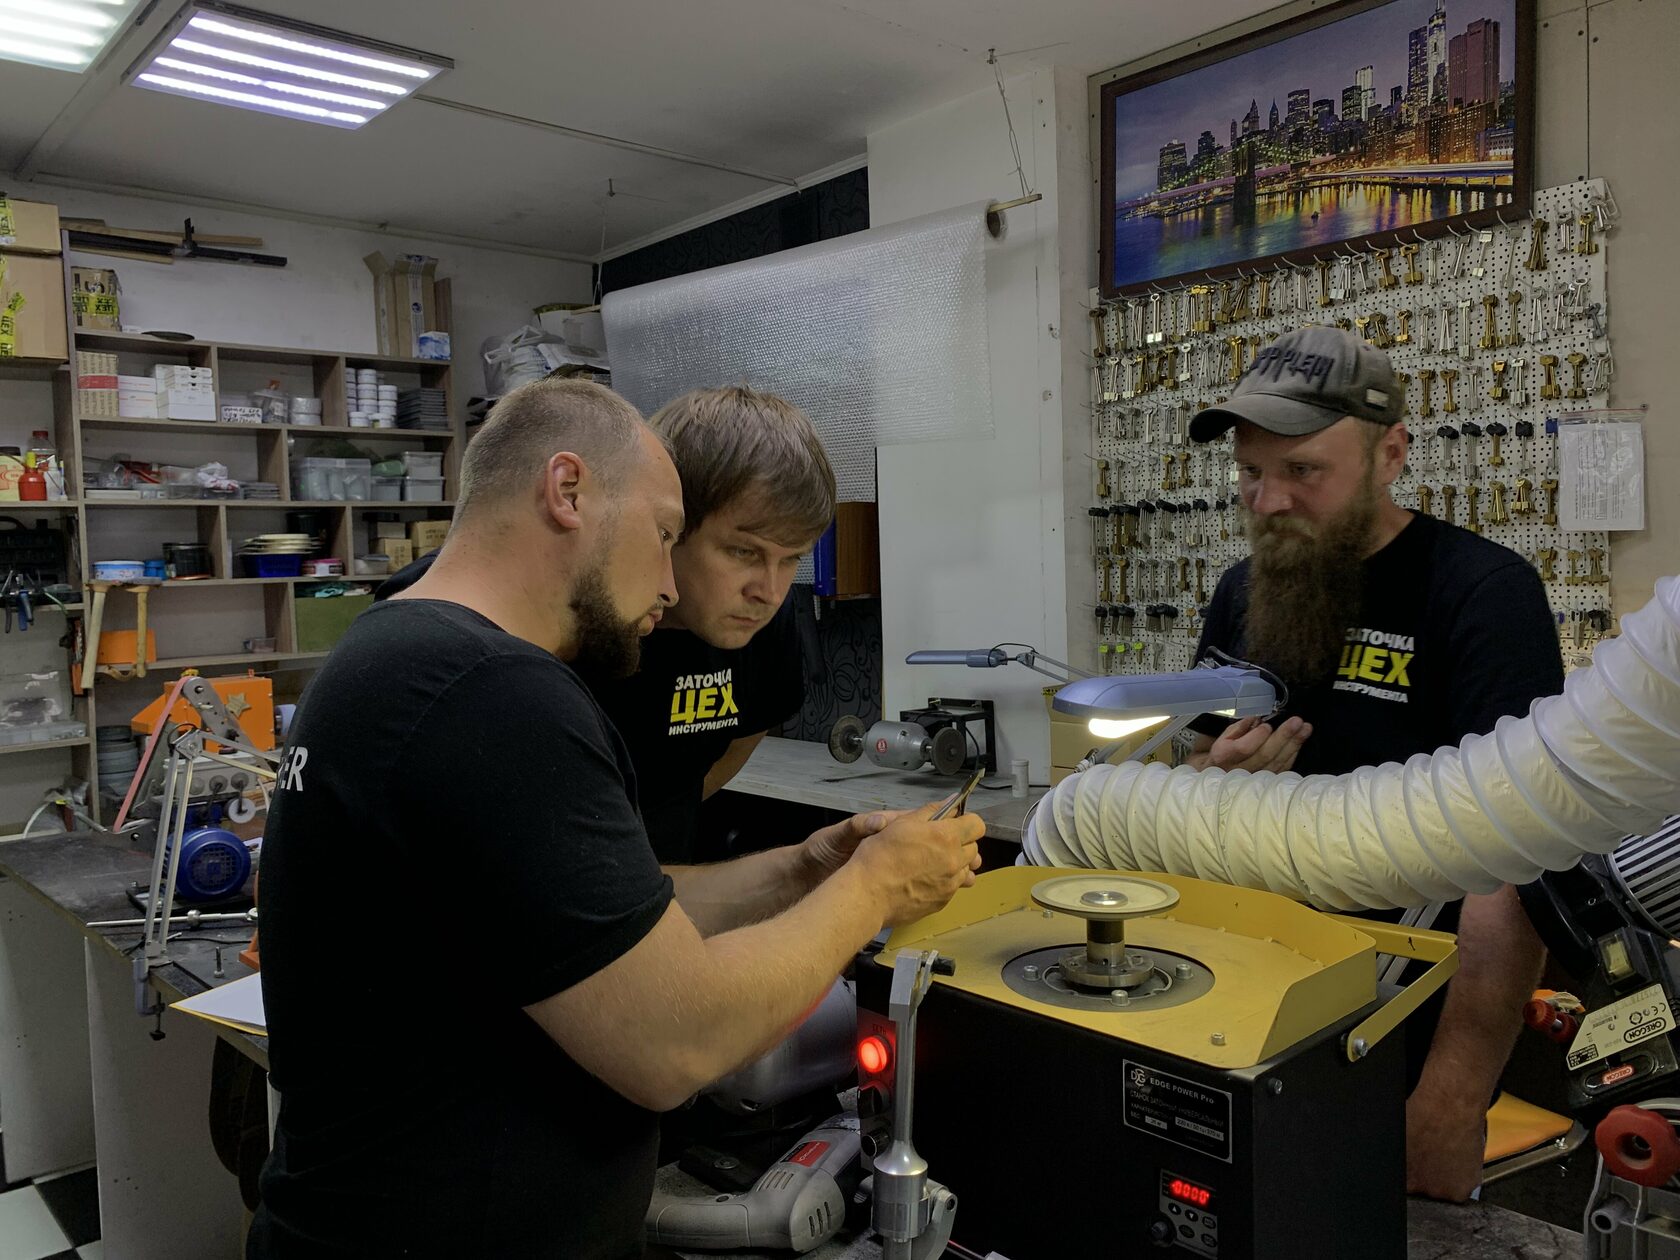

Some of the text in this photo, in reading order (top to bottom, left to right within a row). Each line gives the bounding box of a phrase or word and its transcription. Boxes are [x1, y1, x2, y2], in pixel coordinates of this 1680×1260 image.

[1336, 644, 1415, 687] ЦЕХ
[675, 668, 732, 691] ЗАТОЧКА
[670, 683, 738, 723] ЦЕХ
[668, 717, 739, 736] ИНСТРУМЕНТА
[1628, 1021, 1662, 1040] OREGON
[1606, 1068, 1631, 1082] OREGON
[1150, 1078, 1214, 1104] EDGE POWER Pro
